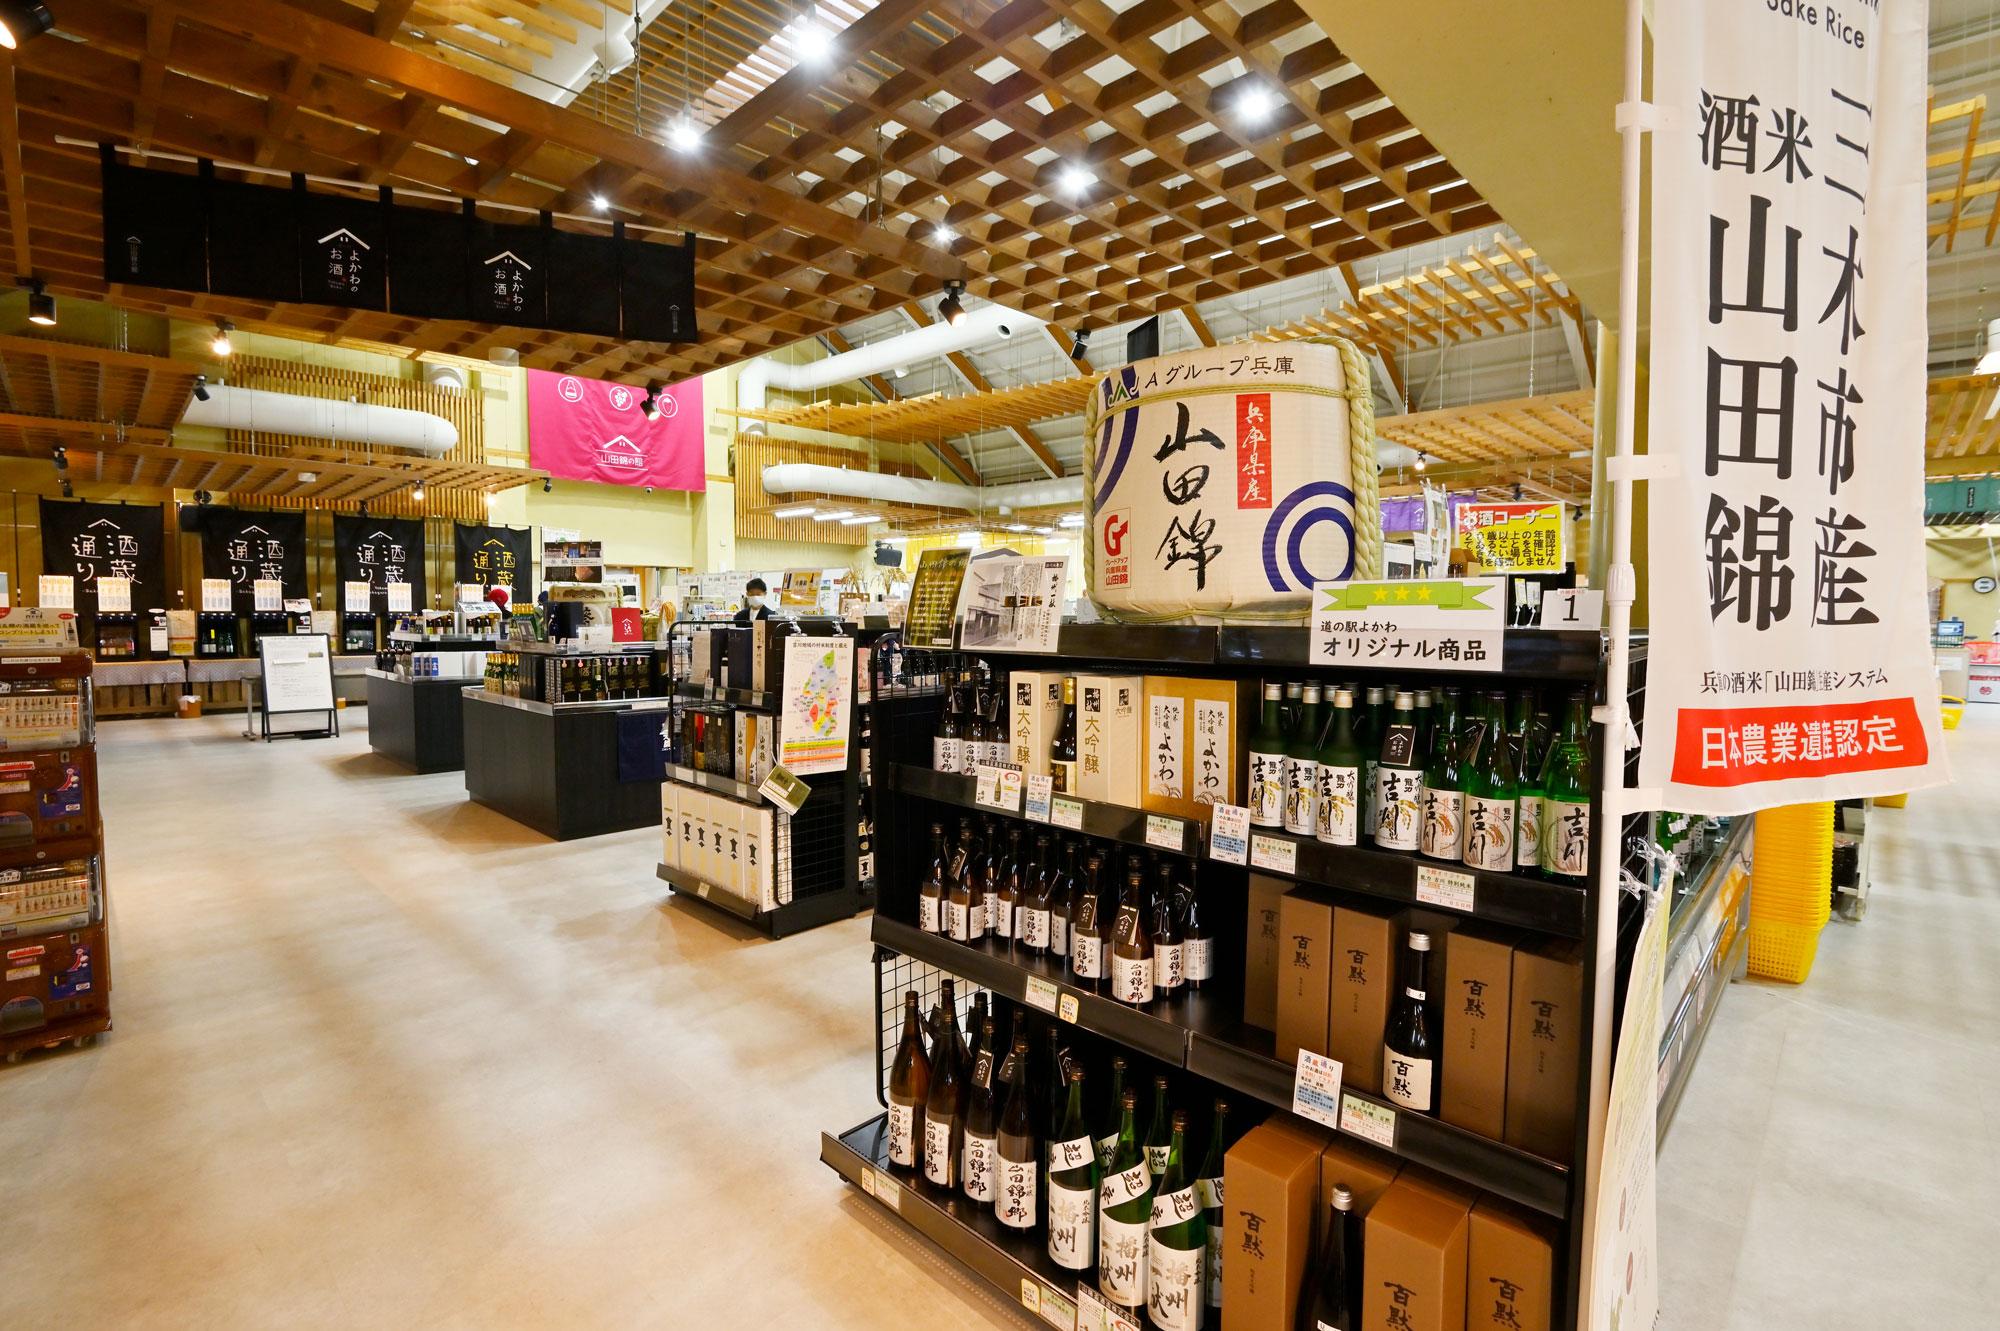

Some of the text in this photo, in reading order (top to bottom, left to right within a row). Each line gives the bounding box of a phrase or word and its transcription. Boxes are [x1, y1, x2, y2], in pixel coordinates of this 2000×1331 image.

[1826, 6, 1865, 49] Rice
[1698, 87, 1813, 184] 酒米
[329, 247, 343, 276] お酒
[349, 250, 362, 293] よかわの
[494, 269, 507, 295] お酒
[512, 270, 524, 312] よかわの
[1811, 88, 1879, 627] 三木市産
[1705, 194, 1802, 631] 山田錦
[1242, 402, 1267, 503] 兵庫県産
[1153, 402, 1225, 592] 山田錦
[1463, 509, 1557, 527] お酒コーナー
[72, 534, 102, 582] 通り
[107, 535, 142, 584] 酒蔵
[228, 540, 253, 583] 通り
[257, 540, 288, 584] 酒蔵
[357, 544, 379, 583] 通り
[382, 544, 405, 583] 酒蔵
[473, 550, 492, 586] 通り
[1106, 574, 1128, 585] 山田錦
[1320, 620, 1397, 633] 道の駅よかわ
[1562, 595, 1580, 622] 1
[1323, 637, 1487, 661] オリジナル商品
[1017, 709, 1031, 764] 大吟醸
[1085, 715, 1100, 774] 大吟醸
[1158, 732, 1175, 781] よかわ
[1701, 714, 1904, 769] 日本農業遺産認定
[1203, 738, 1220, 789] よかわ
[1252, 756, 1266, 813] 吉川
[1288, 762, 1301, 822] 吉川
[1319, 768, 1333, 829] 吉川
[1382, 773, 1401, 837] 吉川
[1404, 778, 1413, 793] 龍力
[1424, 792, 1438, 852] 吉川
[1468, 802, 1487, 866] 吉川
[1502, 807, 1511, 821] 龍力
[1563, 807, 1585, 871] 吉川
[1292, 935, 1313, 970] 百黙
[1347, 949, 1369, 985] 百黙
[1463, 979, 1488, 1020] 百黙
[1531, 1000, 1559, 1042] 百黙
[1392, 1059, 1414, 1098] 百黙
[1240, 1210, 1266, 1260] 百黙
